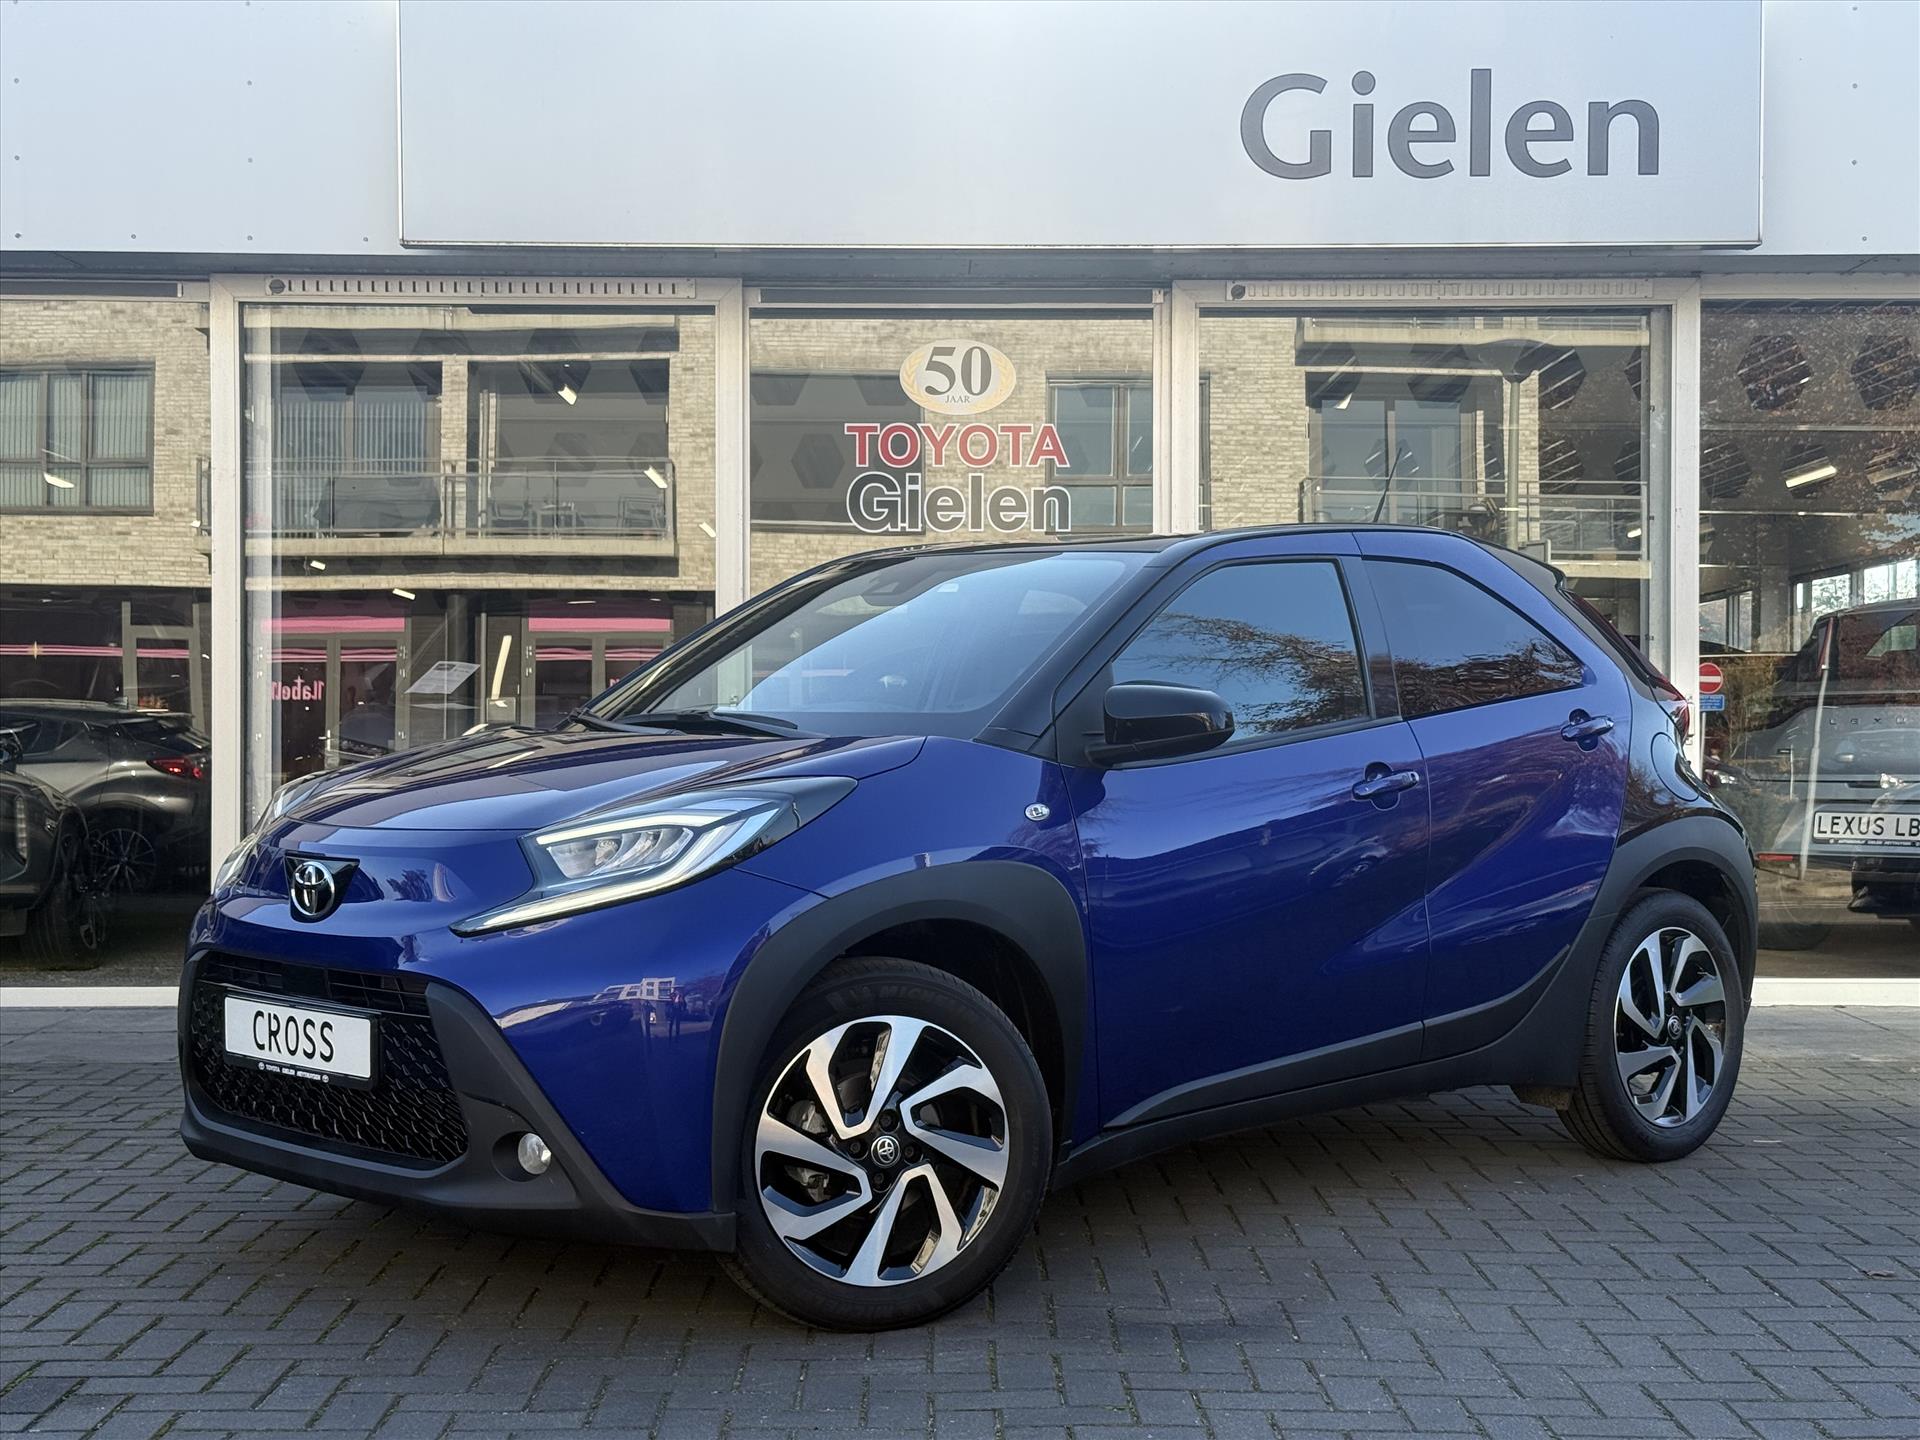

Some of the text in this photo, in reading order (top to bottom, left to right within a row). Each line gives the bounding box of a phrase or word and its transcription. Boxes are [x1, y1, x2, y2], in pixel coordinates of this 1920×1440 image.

[1240, 68, 1660, 180] Gielen
[925, 346, 992, 396] 50
[945, 394, 971, 404] JAAR
[844, 422, 1071, 468] TOYOTA
[846, 471, 1072, 533] Gielen
[1817, 815, 1920, 837] LEXUS LB
[253, 1010, 334, 1063] CROSS
